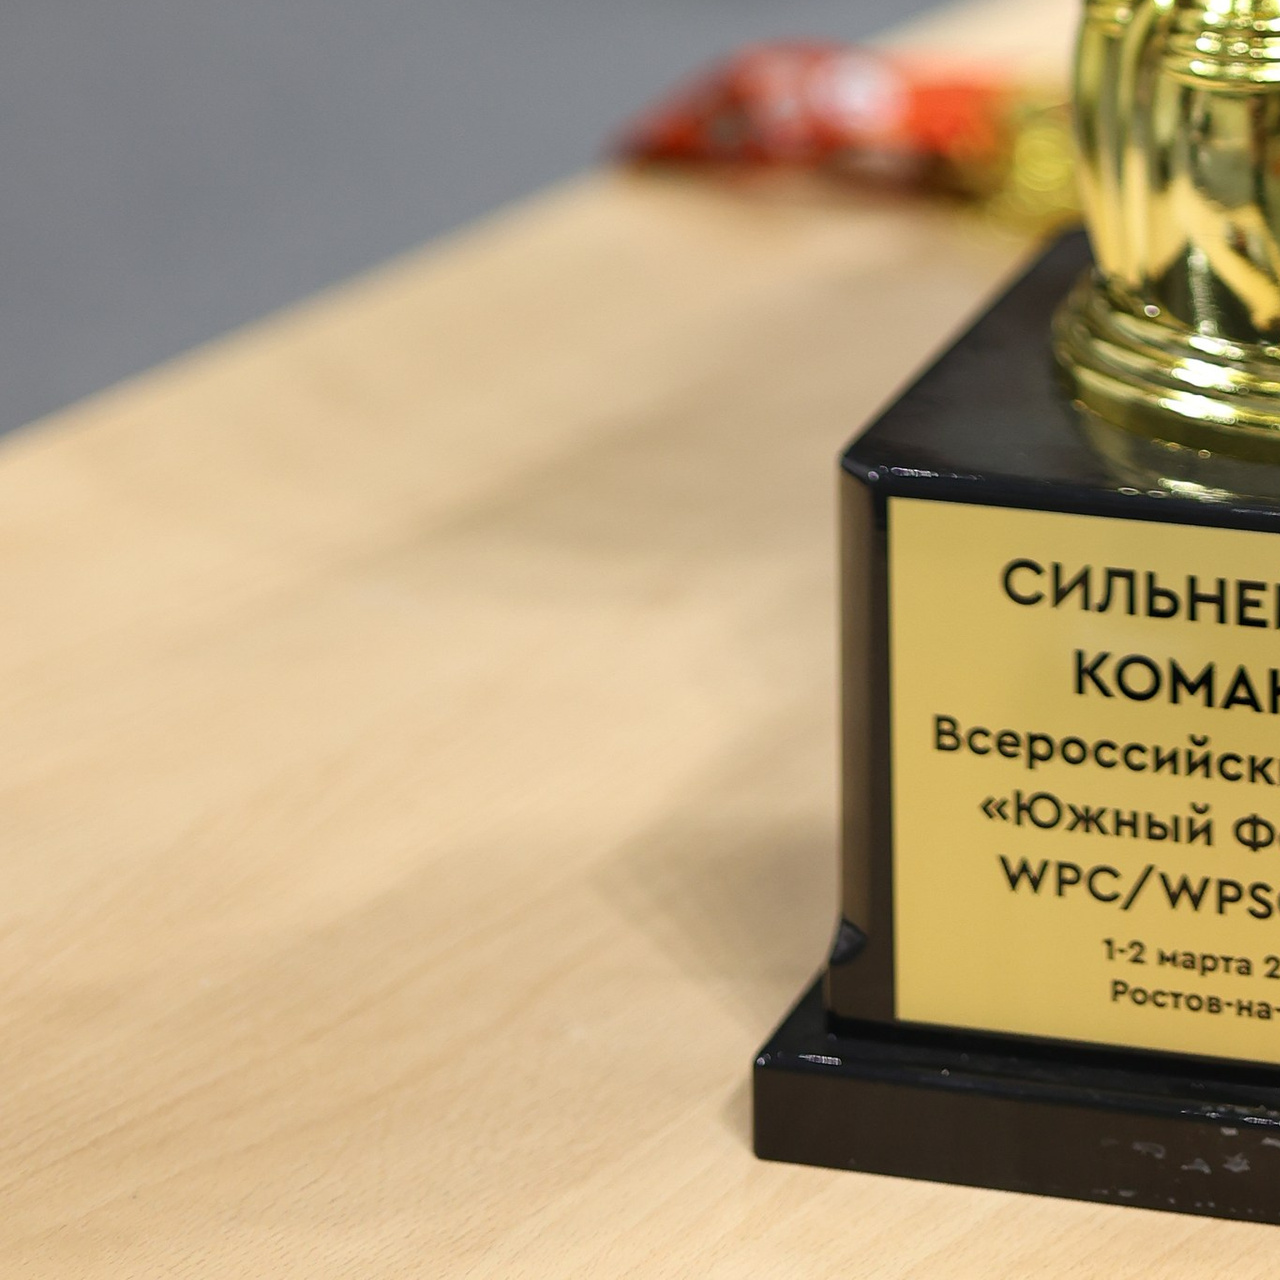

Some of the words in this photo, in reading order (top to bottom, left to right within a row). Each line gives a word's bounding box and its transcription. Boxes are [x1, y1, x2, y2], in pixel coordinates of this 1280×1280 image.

[980, 790, 1213, 847] «Южный
[1103, 938, 1146, 966] 1-2
[1158, 947, 1252, 980] марта
